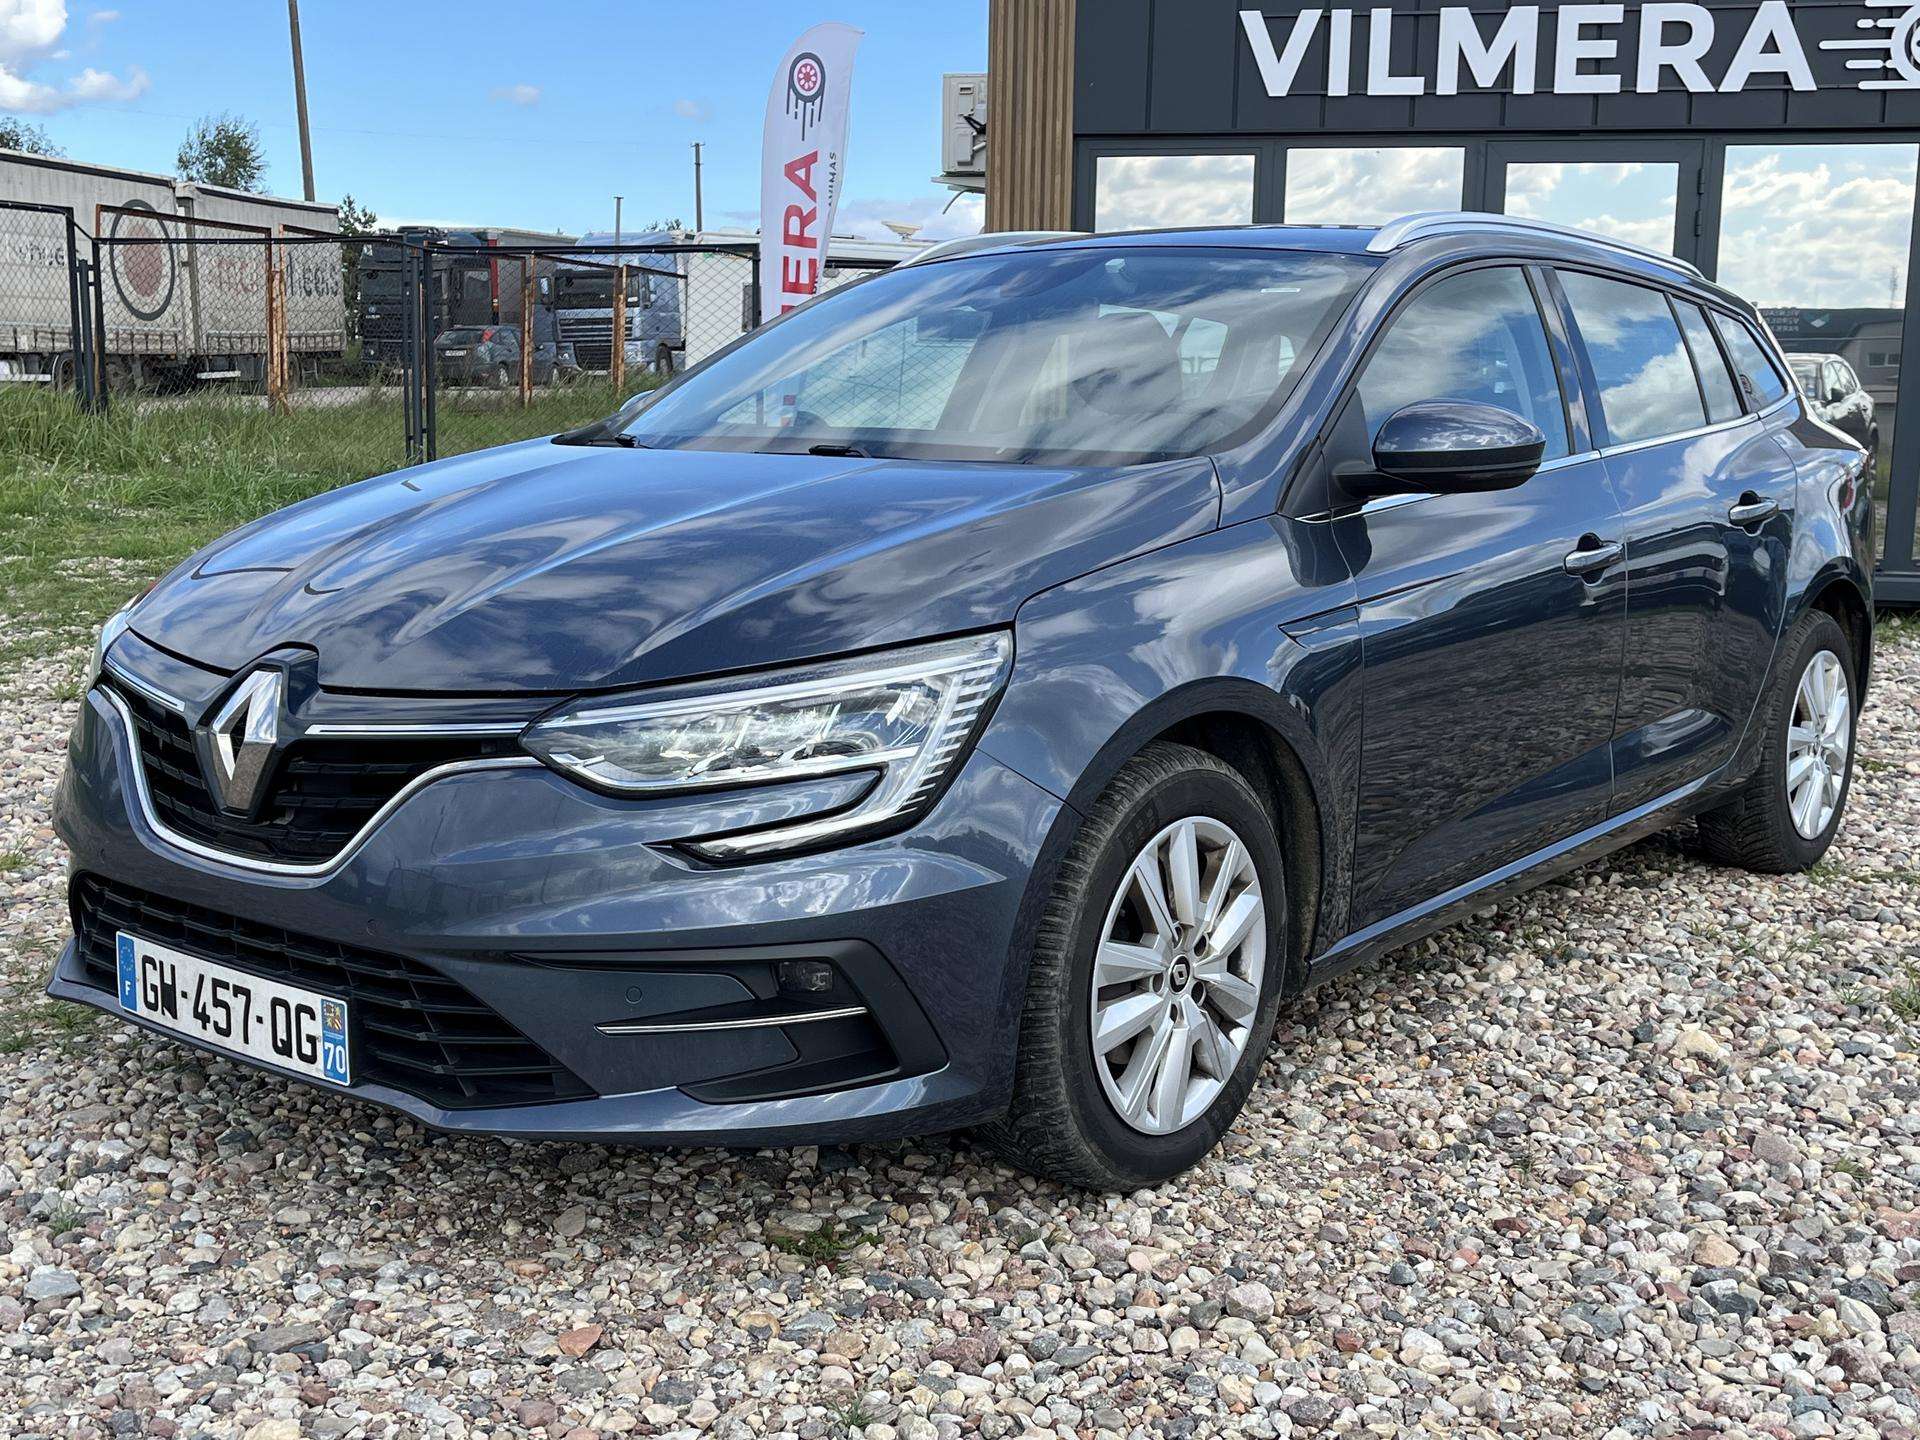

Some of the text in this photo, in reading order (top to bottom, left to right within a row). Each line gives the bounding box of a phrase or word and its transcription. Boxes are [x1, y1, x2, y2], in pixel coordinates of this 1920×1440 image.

[1239, 0, 1818, 97] VILMERA
[781, 150, 818, 315] ERA
[124, 981, 132, 996] F
[141, 954, 319, 1065] GW-457-QG
[324, 1041, 346, 1074] 70
